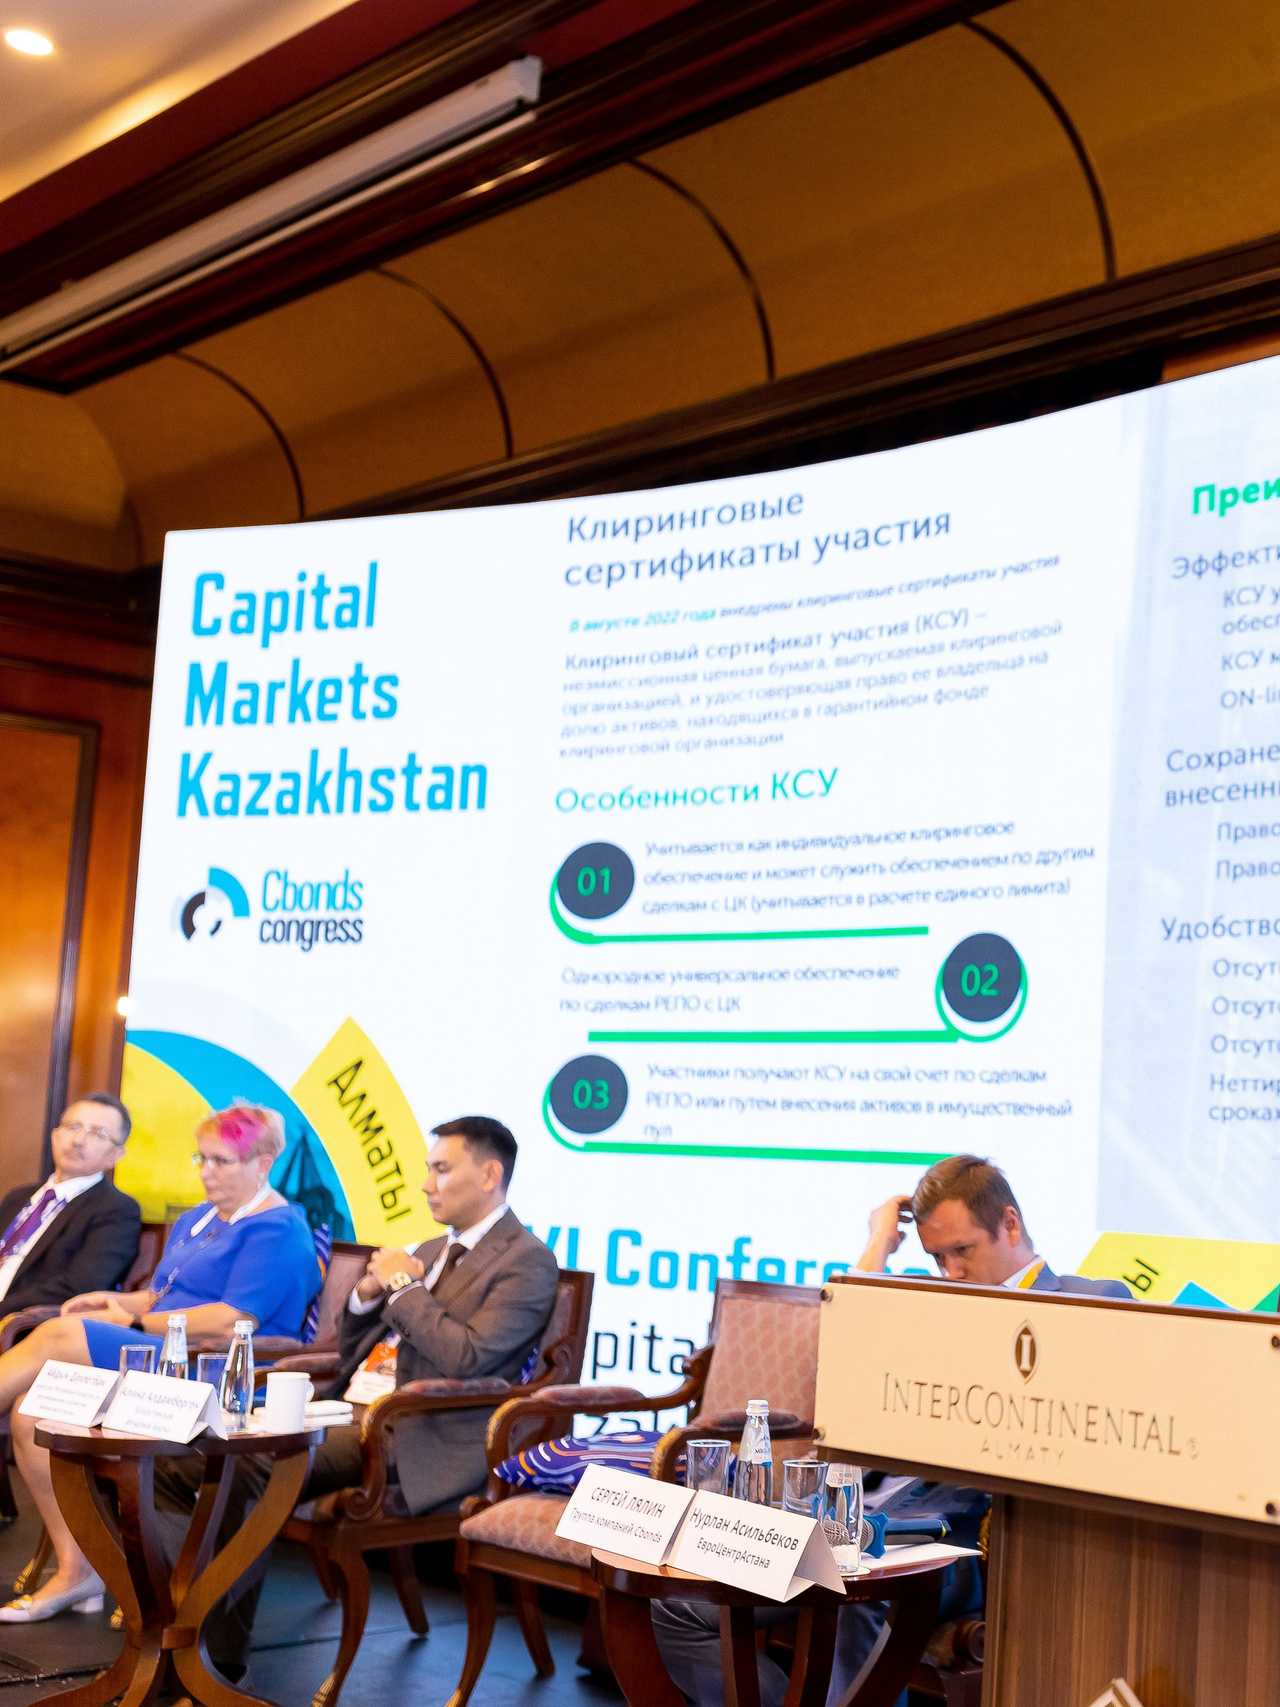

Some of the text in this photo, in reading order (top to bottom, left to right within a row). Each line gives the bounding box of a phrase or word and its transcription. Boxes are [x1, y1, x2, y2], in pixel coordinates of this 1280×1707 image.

[568, 494, 803, 543] Клиринговые
[564, 513, 950, 589] сертификаты участия
[191, 562, 379, 648] Capital
[1223, 584, 1265, 608] КСУ
[565, 608, 969, 671] Клиринговый сертификат участия (КСУ)
[1221, 648, 1264, 672] КСУ
[184, 658, 399, 727] Markets
[176, 747, 489, 818] Kazakhstan
[555, 766, 838, 812] Особенности КСУ
[262, 868, 364, 912] Cbonds
[577, 866, 611, 897] 01
[259, 918, 364, 952] congress
[960, 963, 999, 998] 02
[572, 1078, 611, 1111] 03
[327, 1058, 414, 1224] Алматы
[981, 1438, 1064, 1467] ALMATY
[570, 1508, 595, 1524] Группа
[596, 1514, 635, 1535] компаний
[591, 1487, 666, 1519] СЕРГЕЙ ЛЯЛИН
[689, 1507, 800, 1551] Нурлан Асильбеков
[697, 1537, 770, 1570] ЕвроЦентрАстана
